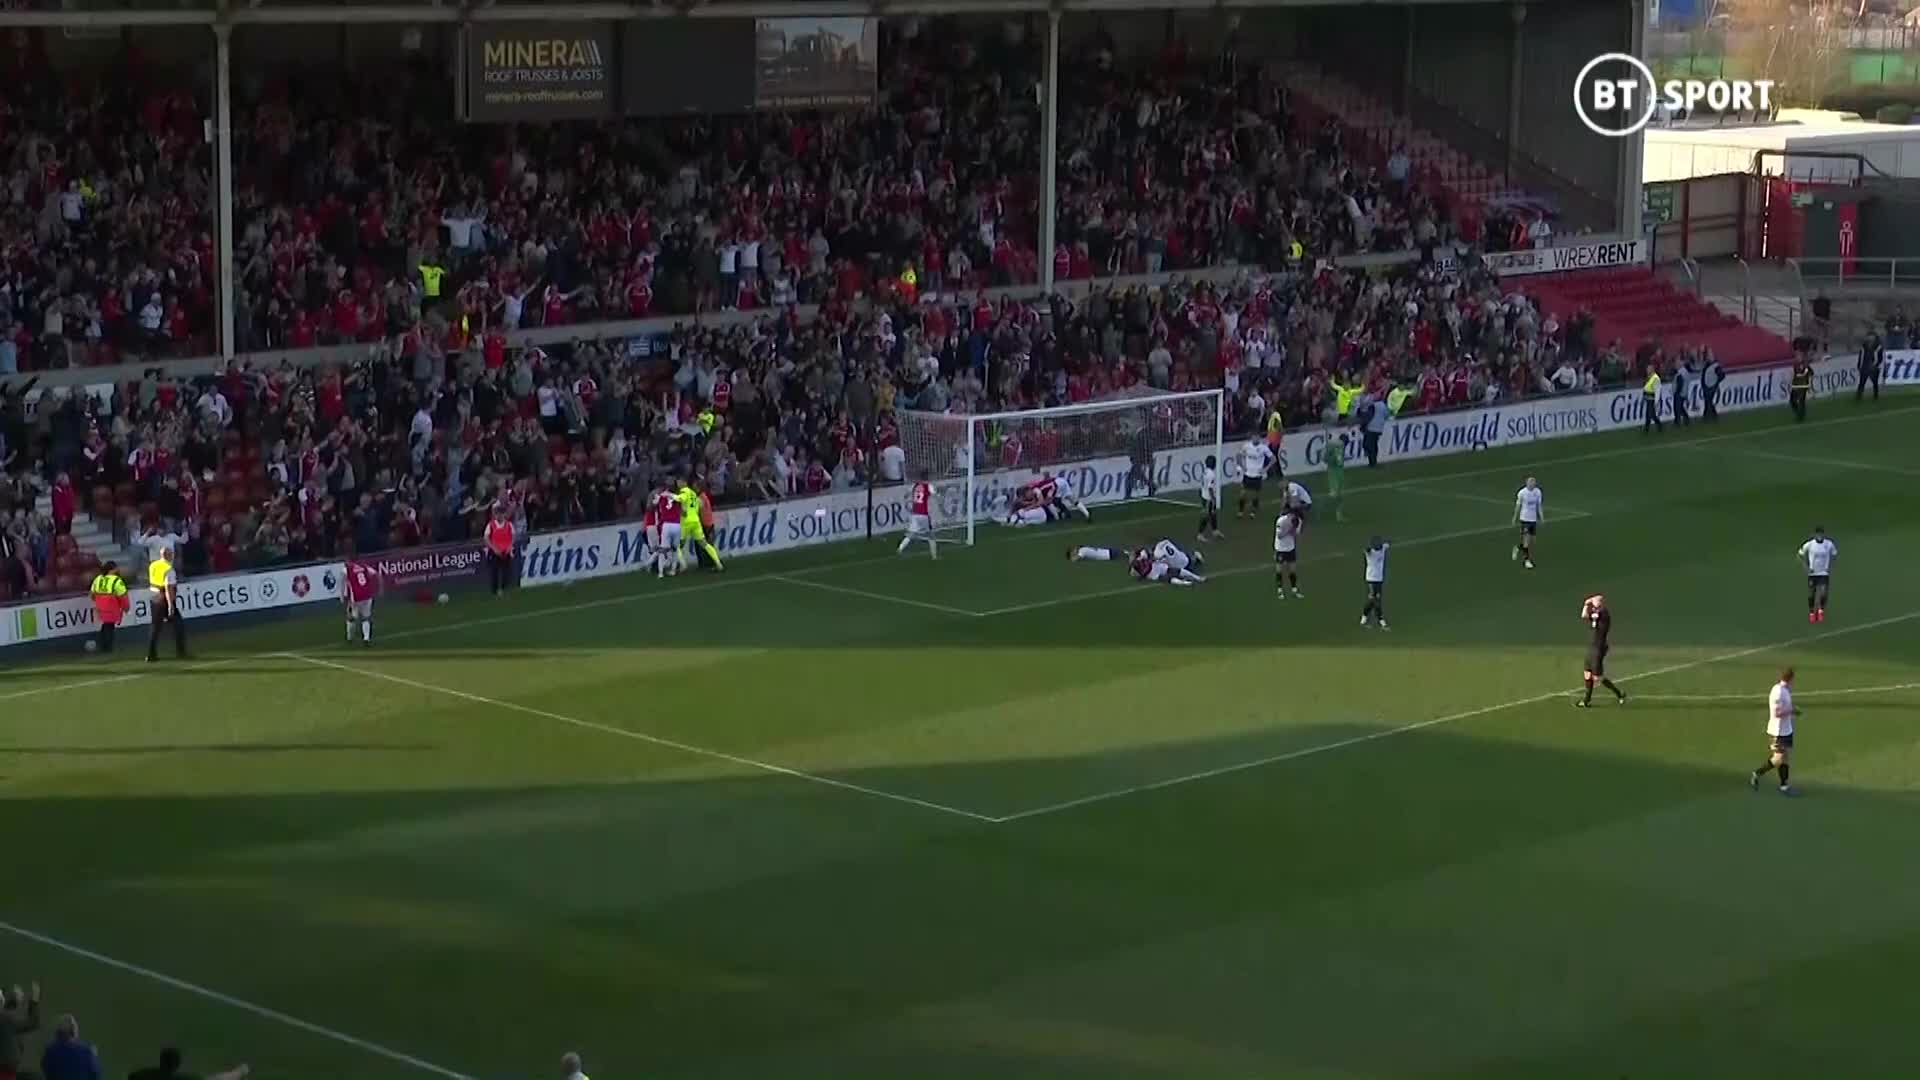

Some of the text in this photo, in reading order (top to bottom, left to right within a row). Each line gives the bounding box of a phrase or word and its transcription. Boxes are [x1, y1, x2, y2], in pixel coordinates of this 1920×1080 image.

[484, 40, 586, 67] MINERA
[515, 70, 559, 81] TRUSSES
[1553, 242, 1637, 268] WREXRENT
[1389, 413, 1500, 456] McDonald
[1507, 408, 1598, 438] SOLICITORS
[379, 554, 433, 575] National
[435, 550, 481, 568] League
[357, 572, 367, 586] 8
